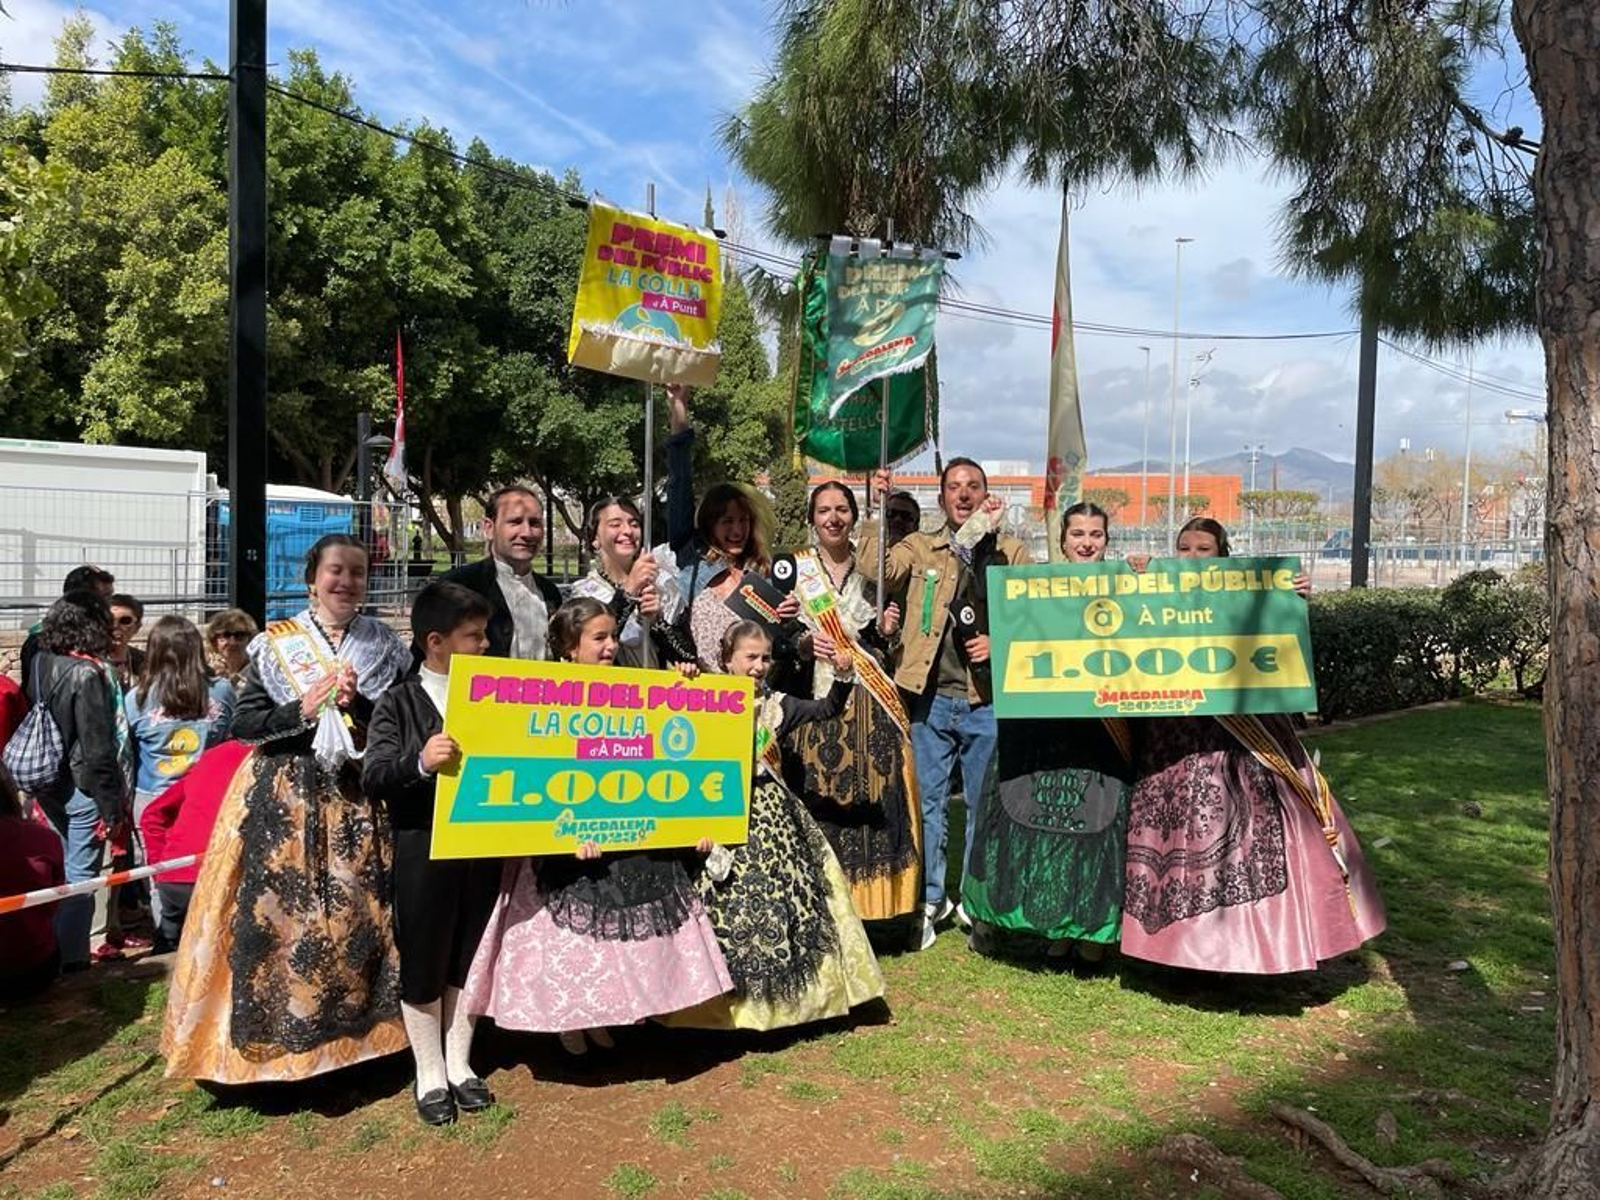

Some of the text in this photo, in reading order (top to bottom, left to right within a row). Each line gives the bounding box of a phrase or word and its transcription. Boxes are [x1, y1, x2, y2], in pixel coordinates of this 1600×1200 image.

[610, 222, 707, 264] PREMI
[597, 244, 713, 284] DEL PÚBLIC
[606, 267, 702, 301] LA COLLA
[672, 300, 699, 316] Punt
[1005, 565, 1295, 600] PREMI DEL PÚBLIC
[1138, 604, 1213, 626] À Punt
[1024, 646, 1280, 680] 1.000 €
[469, 674, 747, 714] PREMI DEL PÚBLIC
[1101, 690, 1204, 704] MAGDALENA
[527, 711, 646, 739] LA COLLA
[612, 742, 644, 758] Punt
[477, 769, 725, 806] 1.000 €
[561, 819, 656, 835] MAGDALENA
